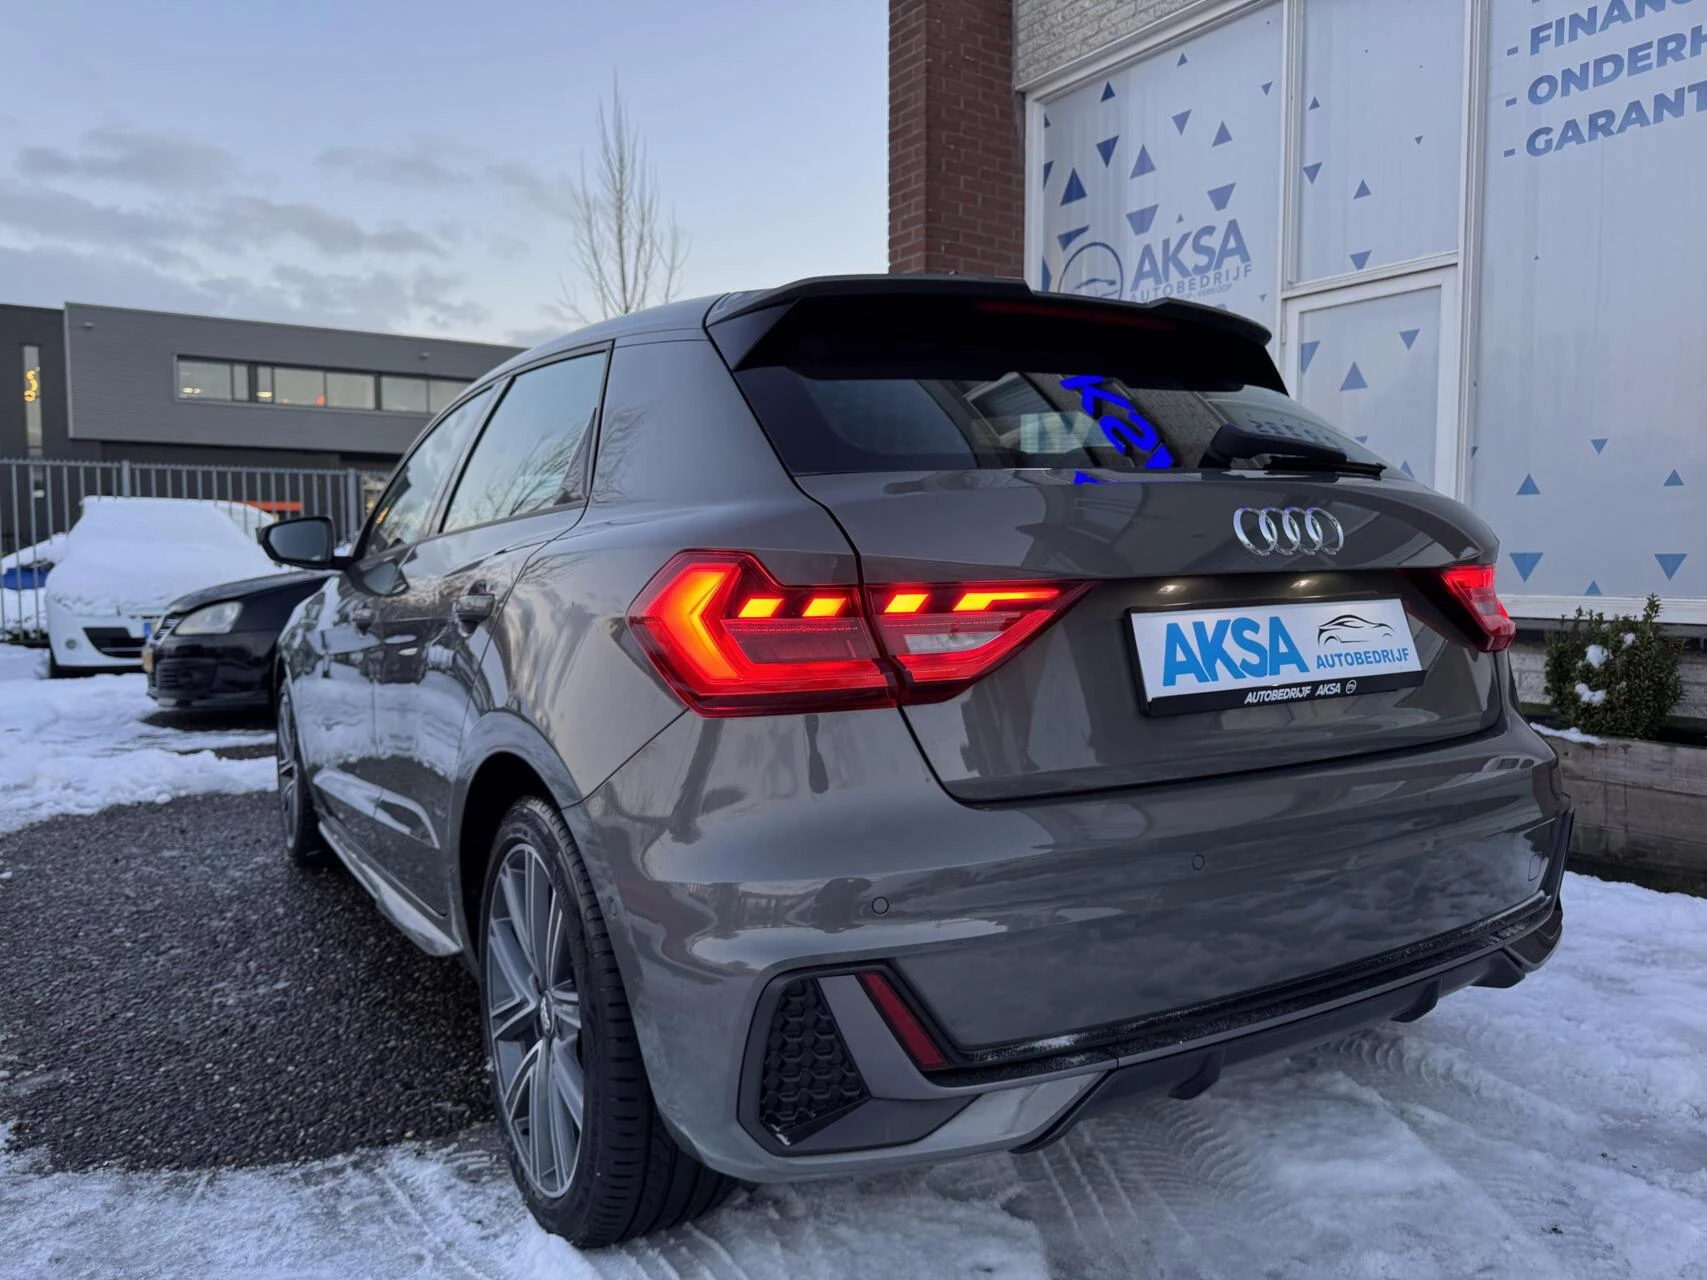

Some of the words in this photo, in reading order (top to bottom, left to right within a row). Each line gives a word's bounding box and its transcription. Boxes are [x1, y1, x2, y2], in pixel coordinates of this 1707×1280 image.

[1529, 0, 1693, 56] FINAN
[1525, 79, 1707, 158] GARANT
[1130, 218, 1252, 292] AKSA
[1130, 263, 1253, 304] AUTOBEDRIJF
[1162, 616, 1310, 687] AKSA
[1315, 648, 1410, 669] AUTOBEDRIJF
[1244, 686, 1312, 705] AUTOBEDRIJF
[1315, 682, 1341, 697] AKSA
